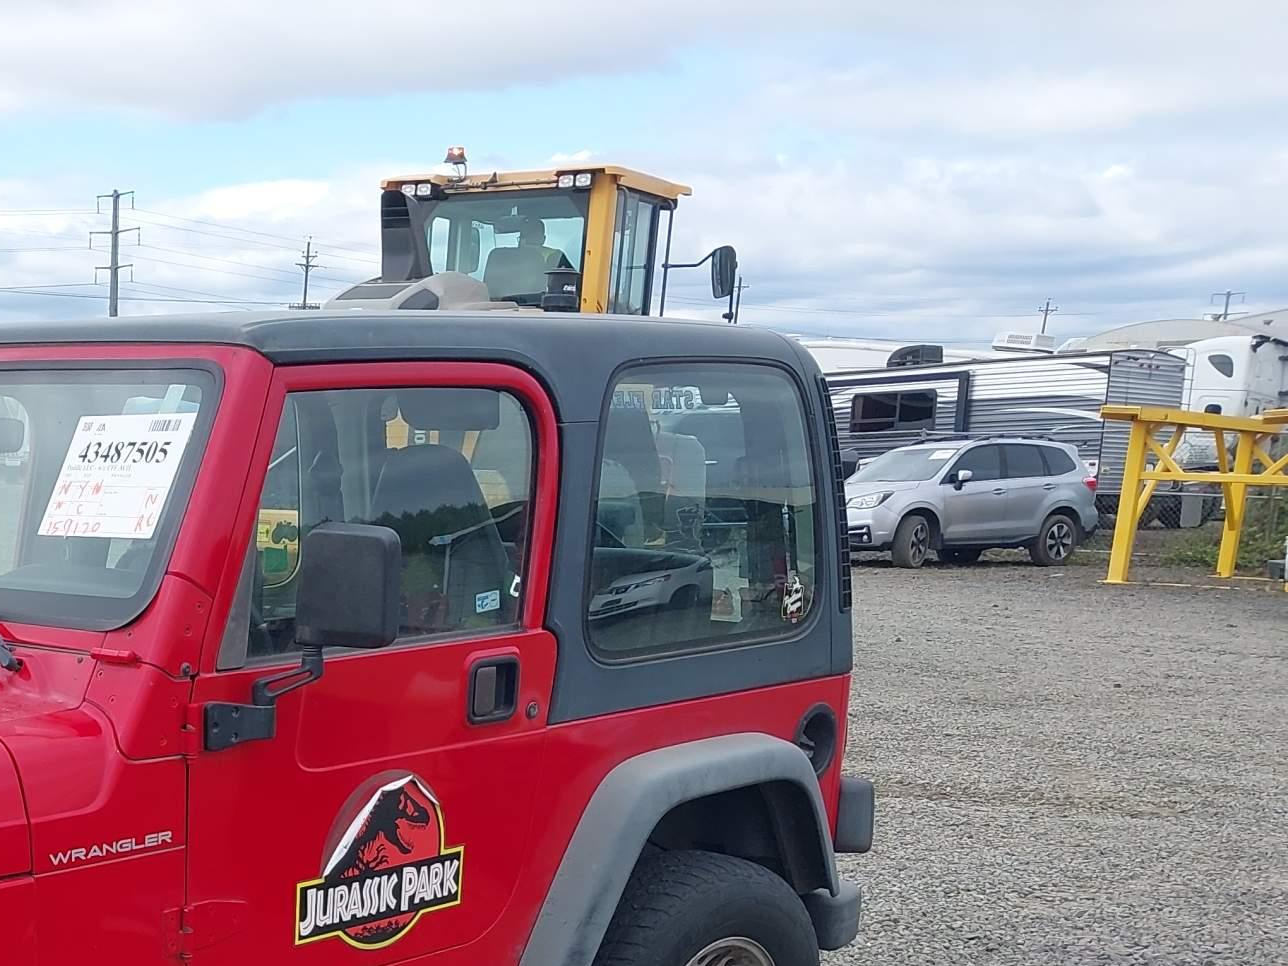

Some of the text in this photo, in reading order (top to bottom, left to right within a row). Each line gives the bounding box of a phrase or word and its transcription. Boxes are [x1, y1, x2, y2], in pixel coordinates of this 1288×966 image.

[78, 440, 173, 464] 43487505
[49, 830, 174, 866] WRANGLER
[299, 856, 460, 938] JURASSIC PARK
